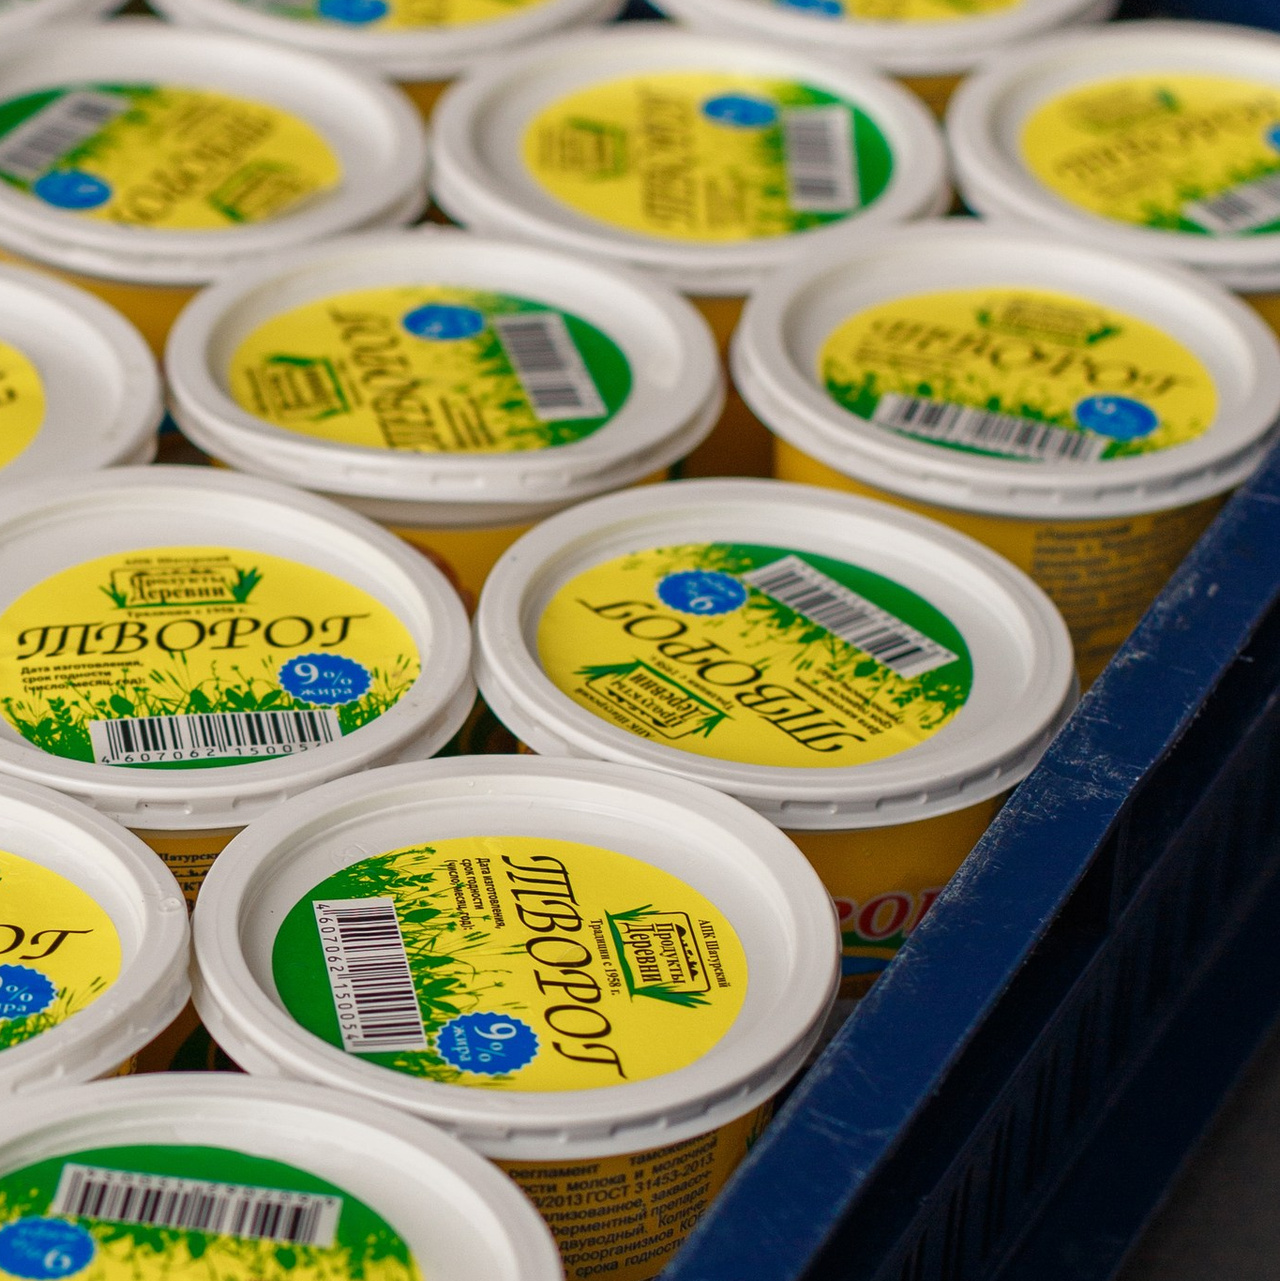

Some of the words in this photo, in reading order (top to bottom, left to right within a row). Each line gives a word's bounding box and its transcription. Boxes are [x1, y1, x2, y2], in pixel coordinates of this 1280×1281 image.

[17, 613, 371, 661] ТВОРОГ
[300, 687, 354, 699] жира
[575, 596, 868, 753] ТВОРОГ
[629, 673, 711, 720] Деревни
[461, 858, 476, 878] срок
[475, 857, 492, 875] Дата
[444, 859, 460, 887] (число,
[453, 886, 468, 916] месяц,
[466, 877, 486, 911] годности
[482, 874, 507, 930] изготовления,
[588, 918, 612, 961] Традиции
[697, 919, 717, 940] АПК
[501, 855, 628, 1079] ТВОРОГ
[618, 922, 663, 983] Деревни
[653, 922, 687, 985] Продукты
[705, 939, 732, 989] Шатурский
[604, 968, 622, 988] 1958
[610, 989, 621, 997] г.
[450, 1024, 472, 1063] жира
[521, 1183, 558, 1195] ости
[566, 1174, 627, 1193] молока
[634, 1169, 645, 1180] и
[652, 1136, 718, 1175] молочной
[541, 1197, 647, 1222] лизованное,
[585, 1184, 630, 1205] ГОСТ
[650, 1182, 712, 1219] препарат
[559, 1225, 648, 1252] двуводный.
[658, 1198, 709, 1229] Количе-
[575, 1260, 619, 1279] срока
